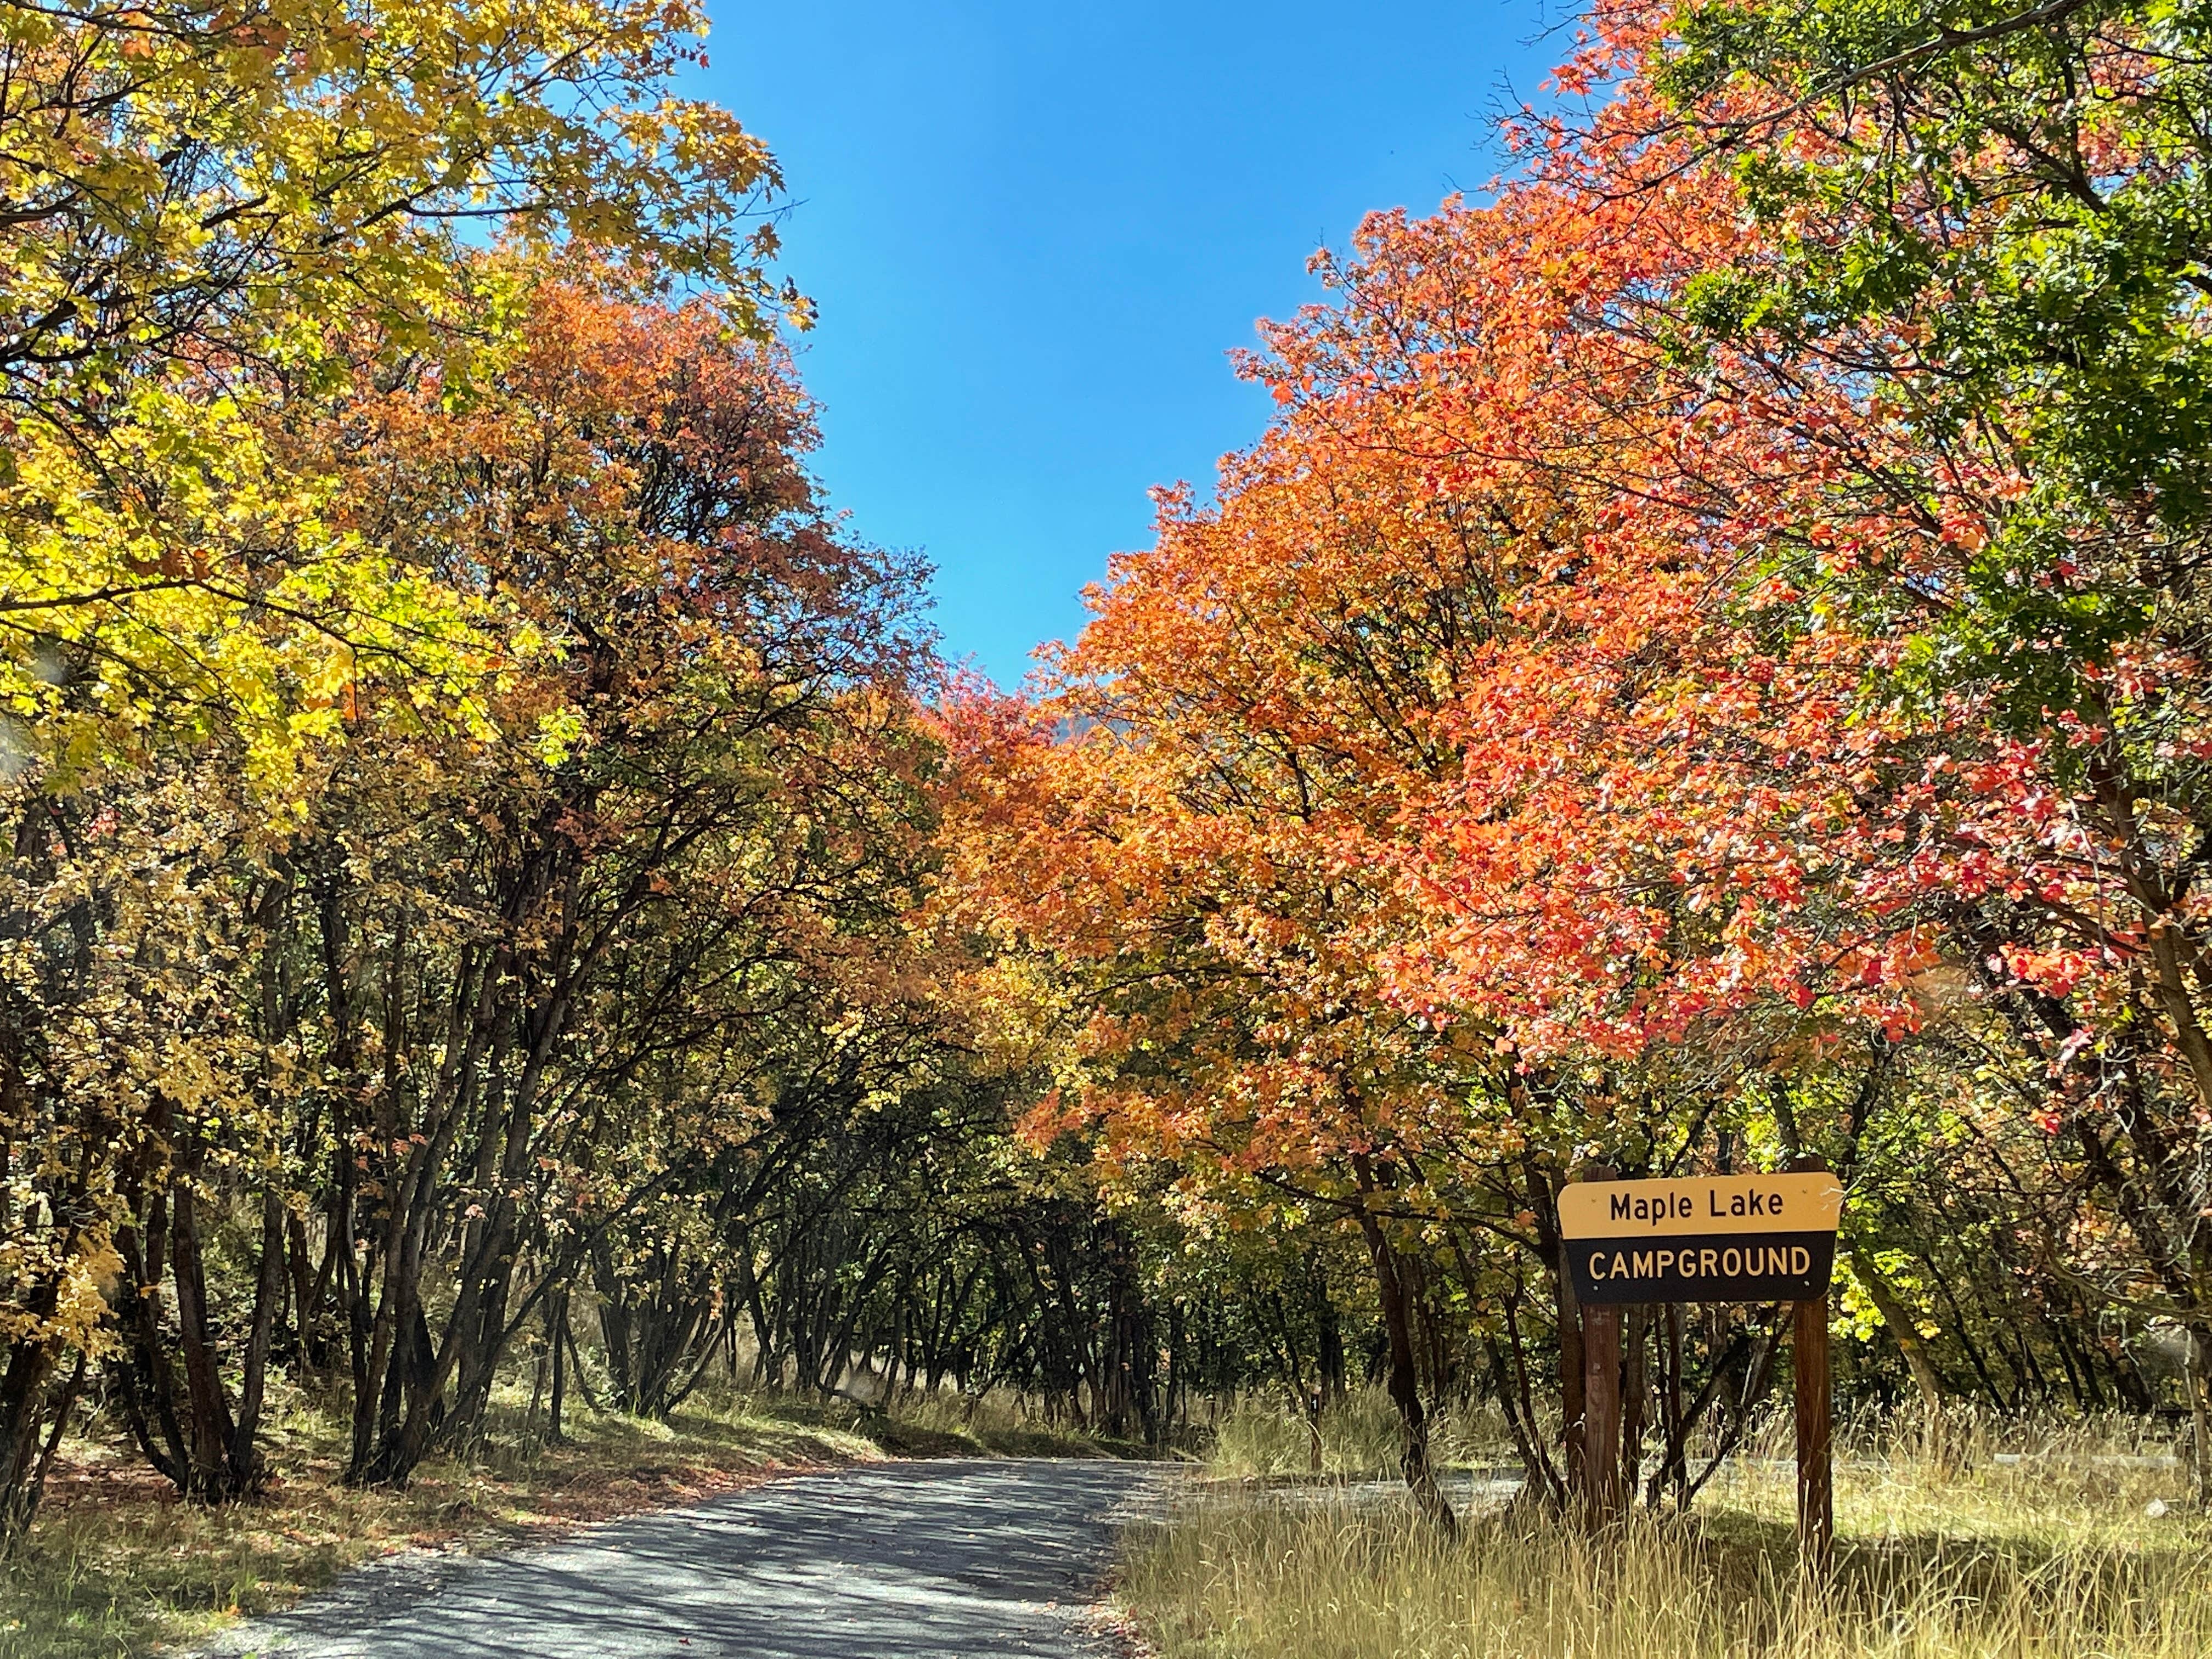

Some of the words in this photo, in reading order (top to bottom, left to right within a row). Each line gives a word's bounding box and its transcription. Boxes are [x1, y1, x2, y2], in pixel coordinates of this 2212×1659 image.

[1610, 1191, 1692, 1226] Maple
[1709, 1188, 1784, 1217] Lake
[1589, 1246, 1810, 1280] CAMPGROUND
[1312, 1400, 1317, 1409] 1
